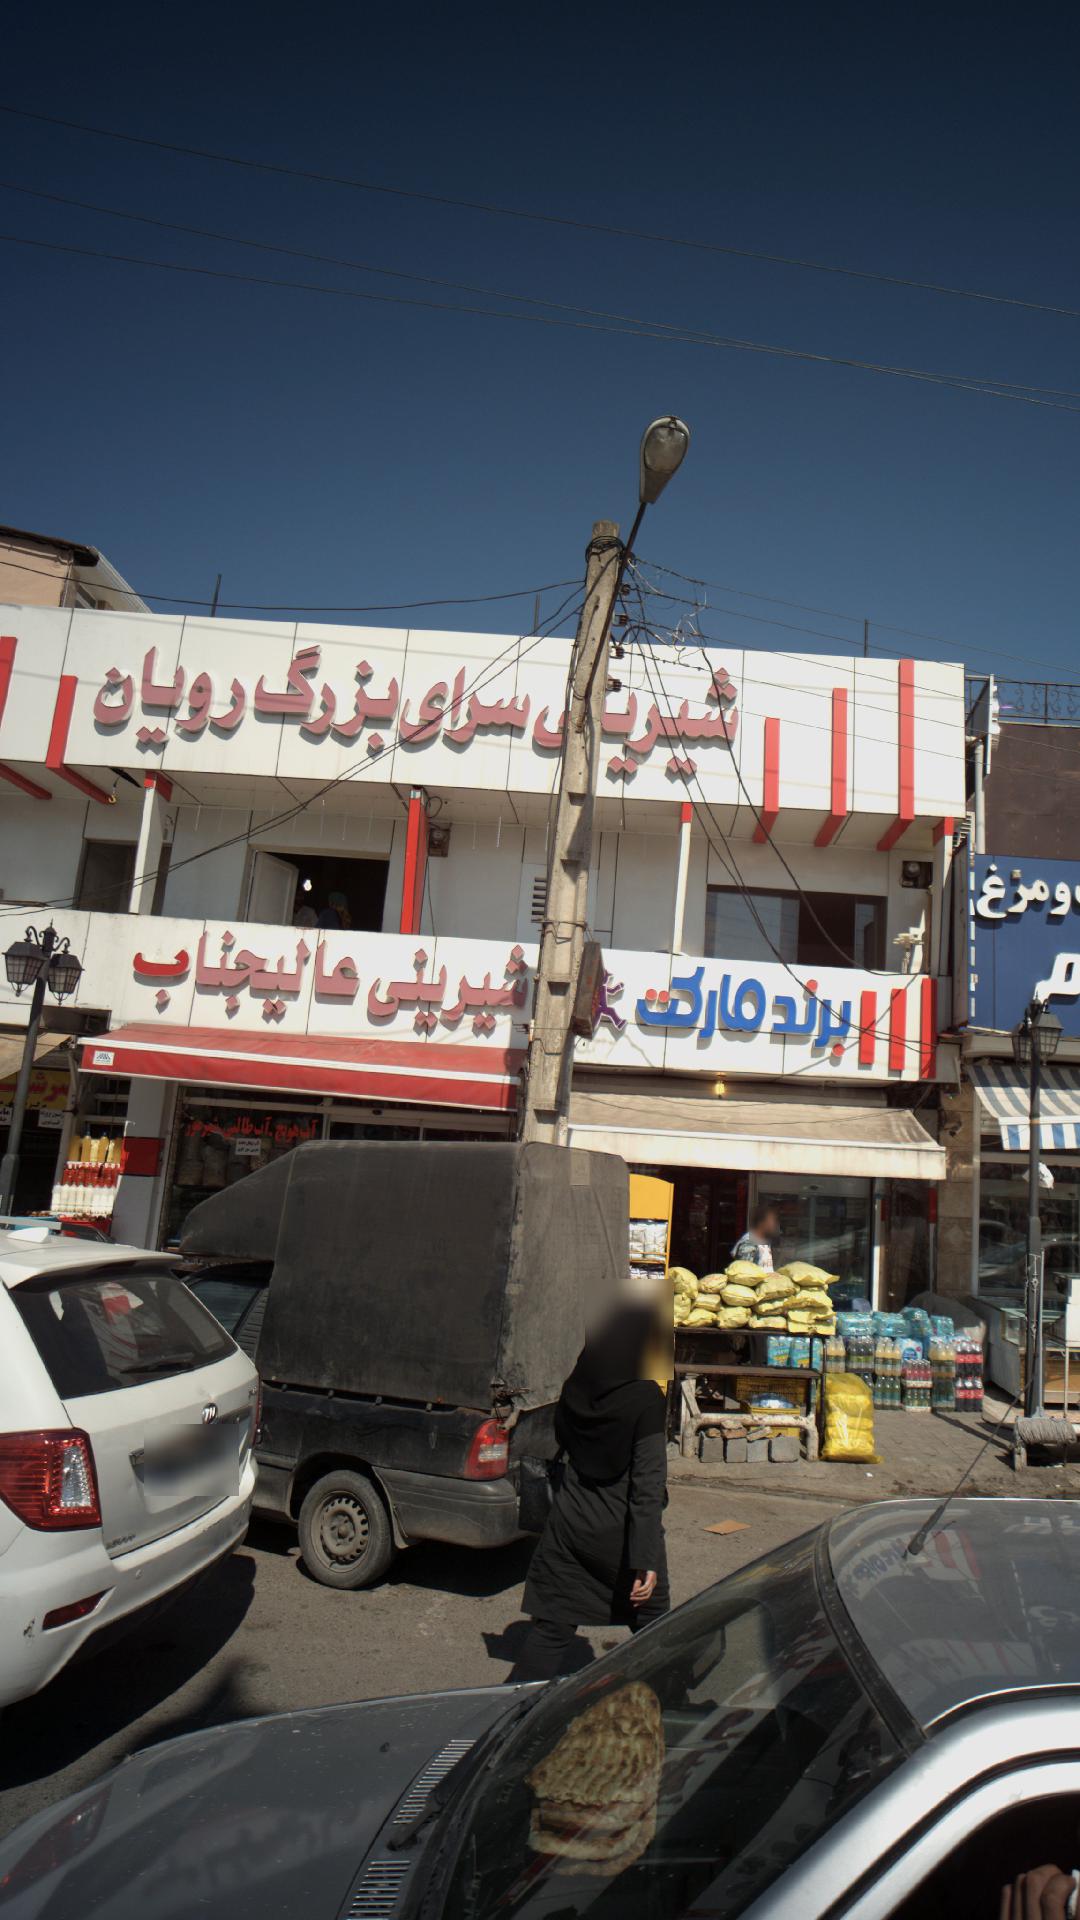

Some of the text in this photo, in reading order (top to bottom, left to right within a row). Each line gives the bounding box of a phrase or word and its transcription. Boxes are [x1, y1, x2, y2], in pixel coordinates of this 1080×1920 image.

[93, 645, 739, 775] شیریی سرای بزرگ رویان
[368, 944, 528, 1030] شیرینی
[636, 966, 852, 1057] برند مارکت
